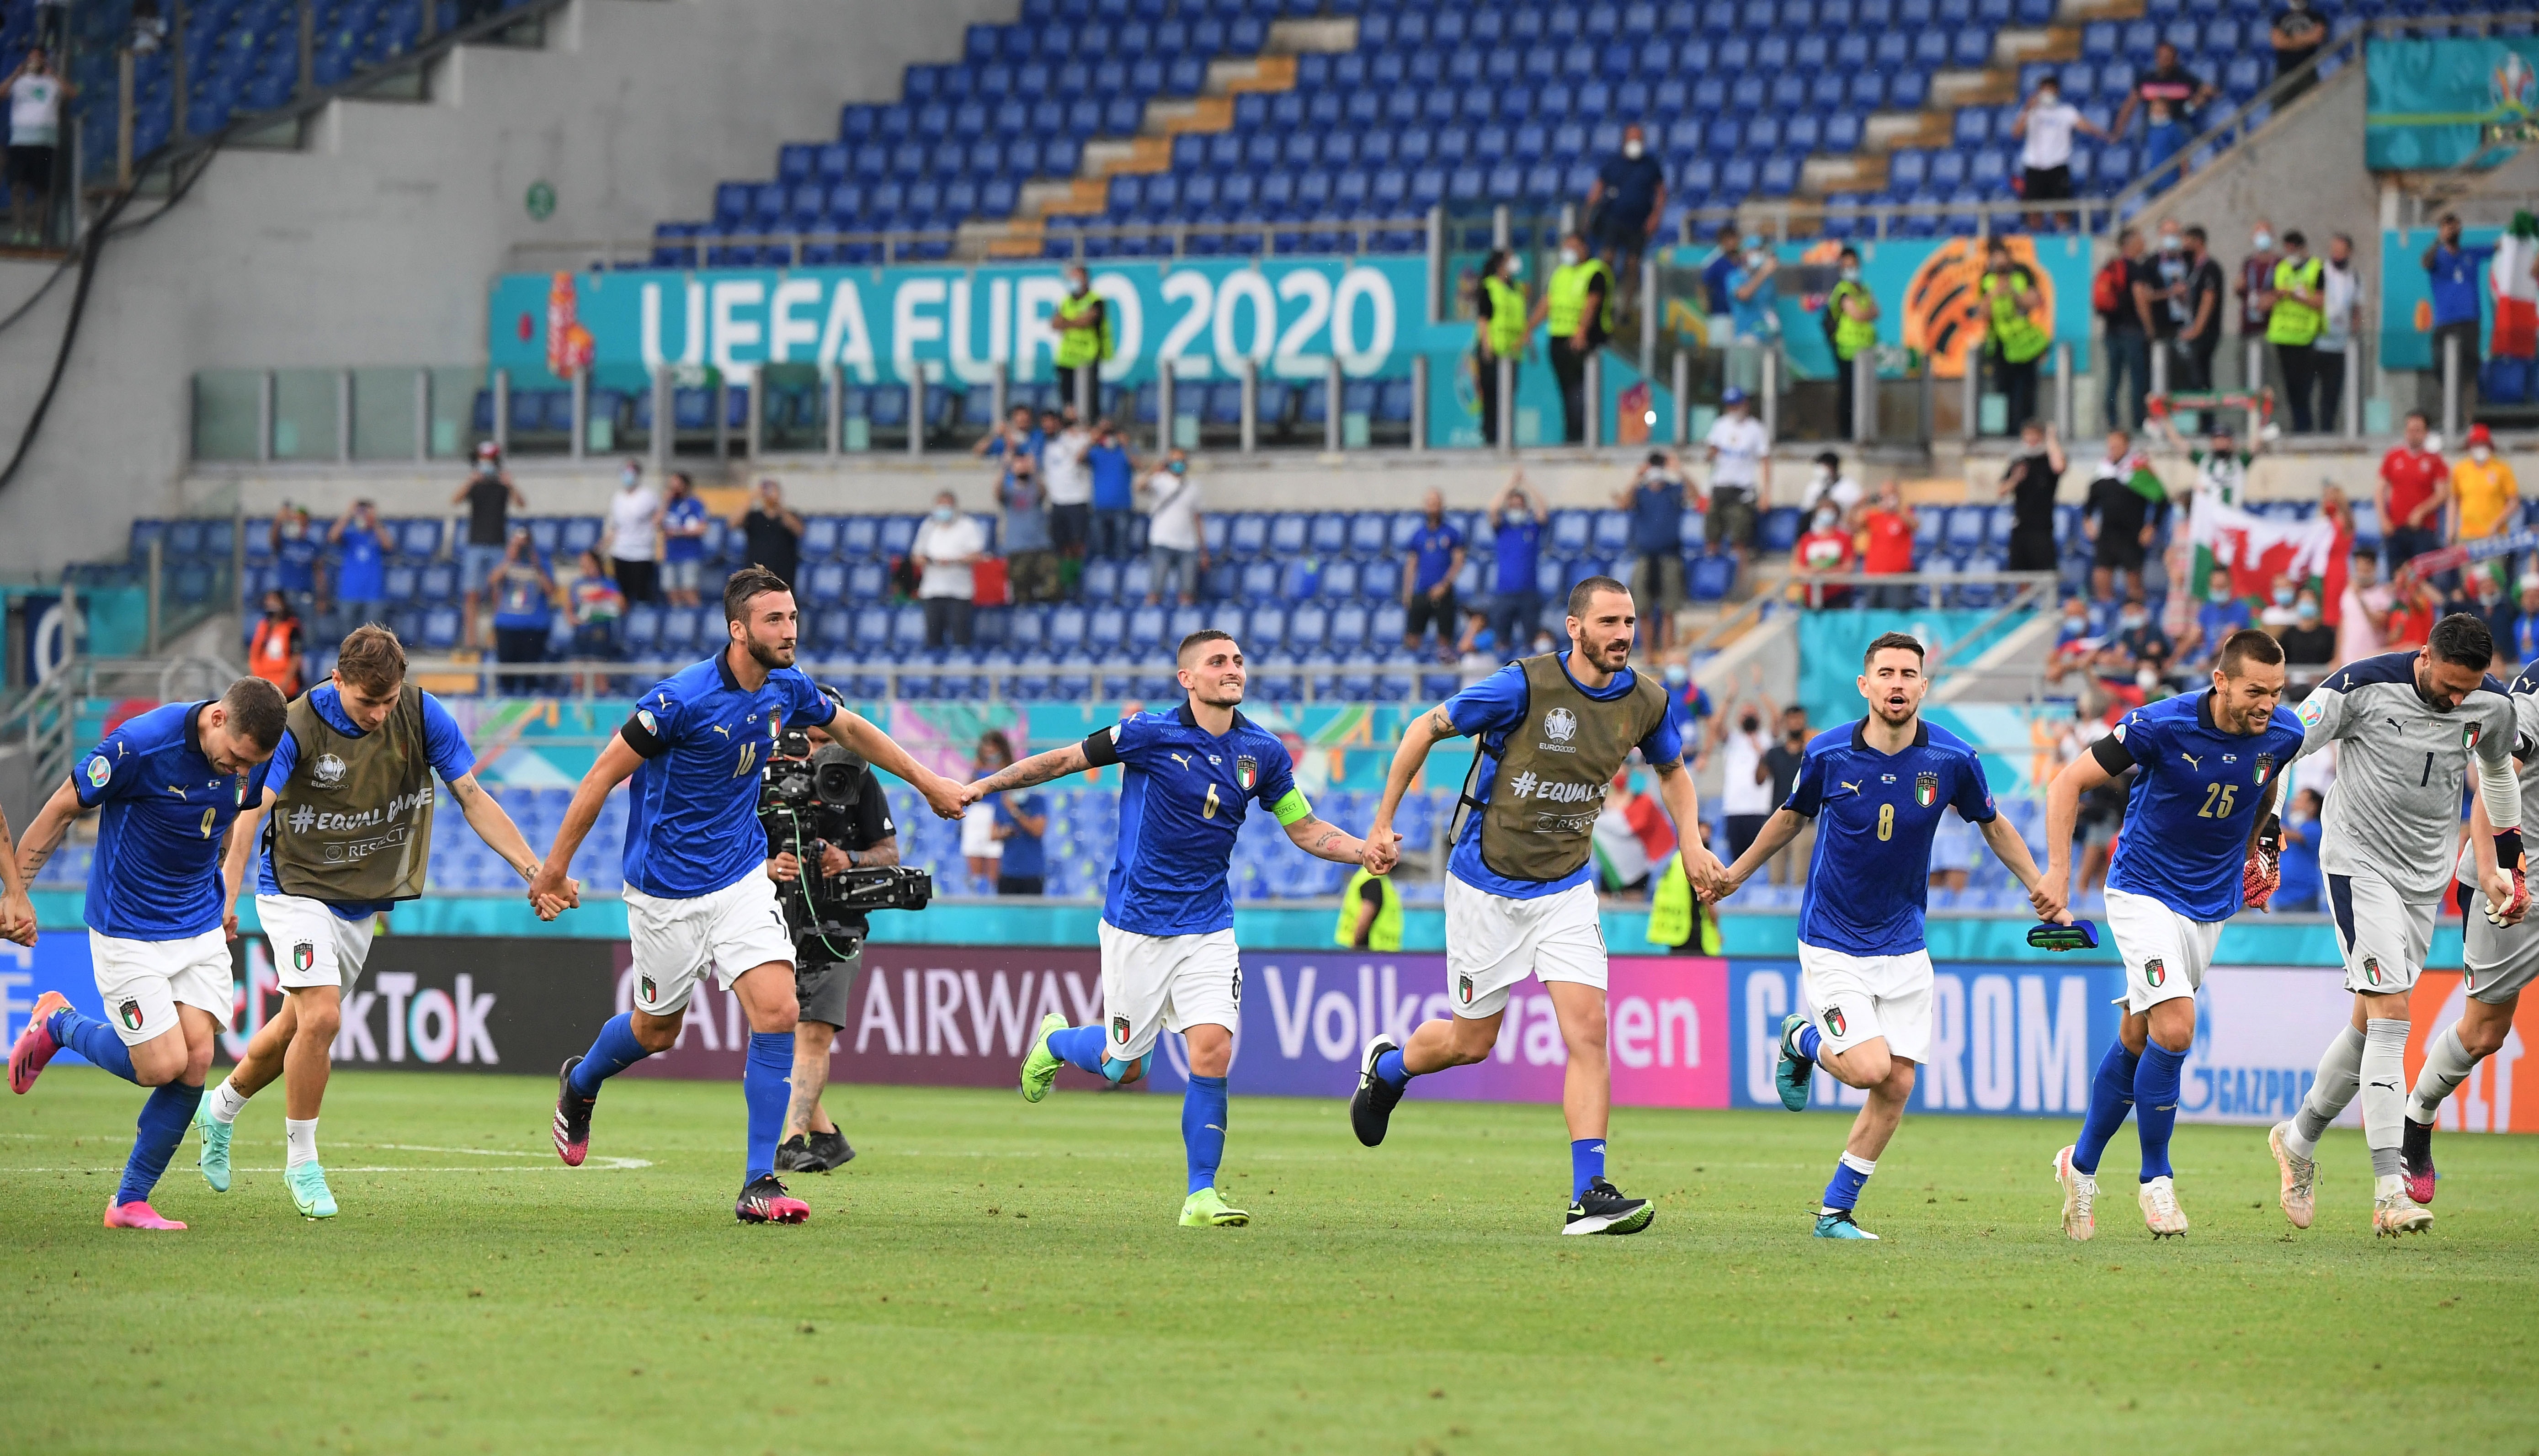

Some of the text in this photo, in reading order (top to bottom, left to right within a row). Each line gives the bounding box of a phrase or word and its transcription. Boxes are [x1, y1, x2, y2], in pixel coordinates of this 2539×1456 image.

[640, 267, 1397, 385] UEFA EURO 2020
[732, 741, 756, 779] 16
[2420, 751, 2435, 787] 1
[1203, 783, 1219, 819] 6
[1511, 770, 1595, 803] #EQUAL
[2197, 782, 2239, 818] 25
[200, 807, 216, 840] 9
[289, 787, 433, 834] #EQUAL GAME
[1556, 812, 1599, 830] RESPEC
[1877, 803, 1894, 841] 8
[349, 827, 405, 857] RESCT
[2145, 960, 2161, 969] ITALIA
[329, 971, 500, 1064] kTok
[854, 966, 1102, 1057] AIRWAY
[1262, 965, 1701, 1068] Volkaen
[1825, 1009, 1840, 1020] ITALIA
[1746, 970, 2089, 1112] GROM
[2219, 1068, 2316, 1116] GAZPR
